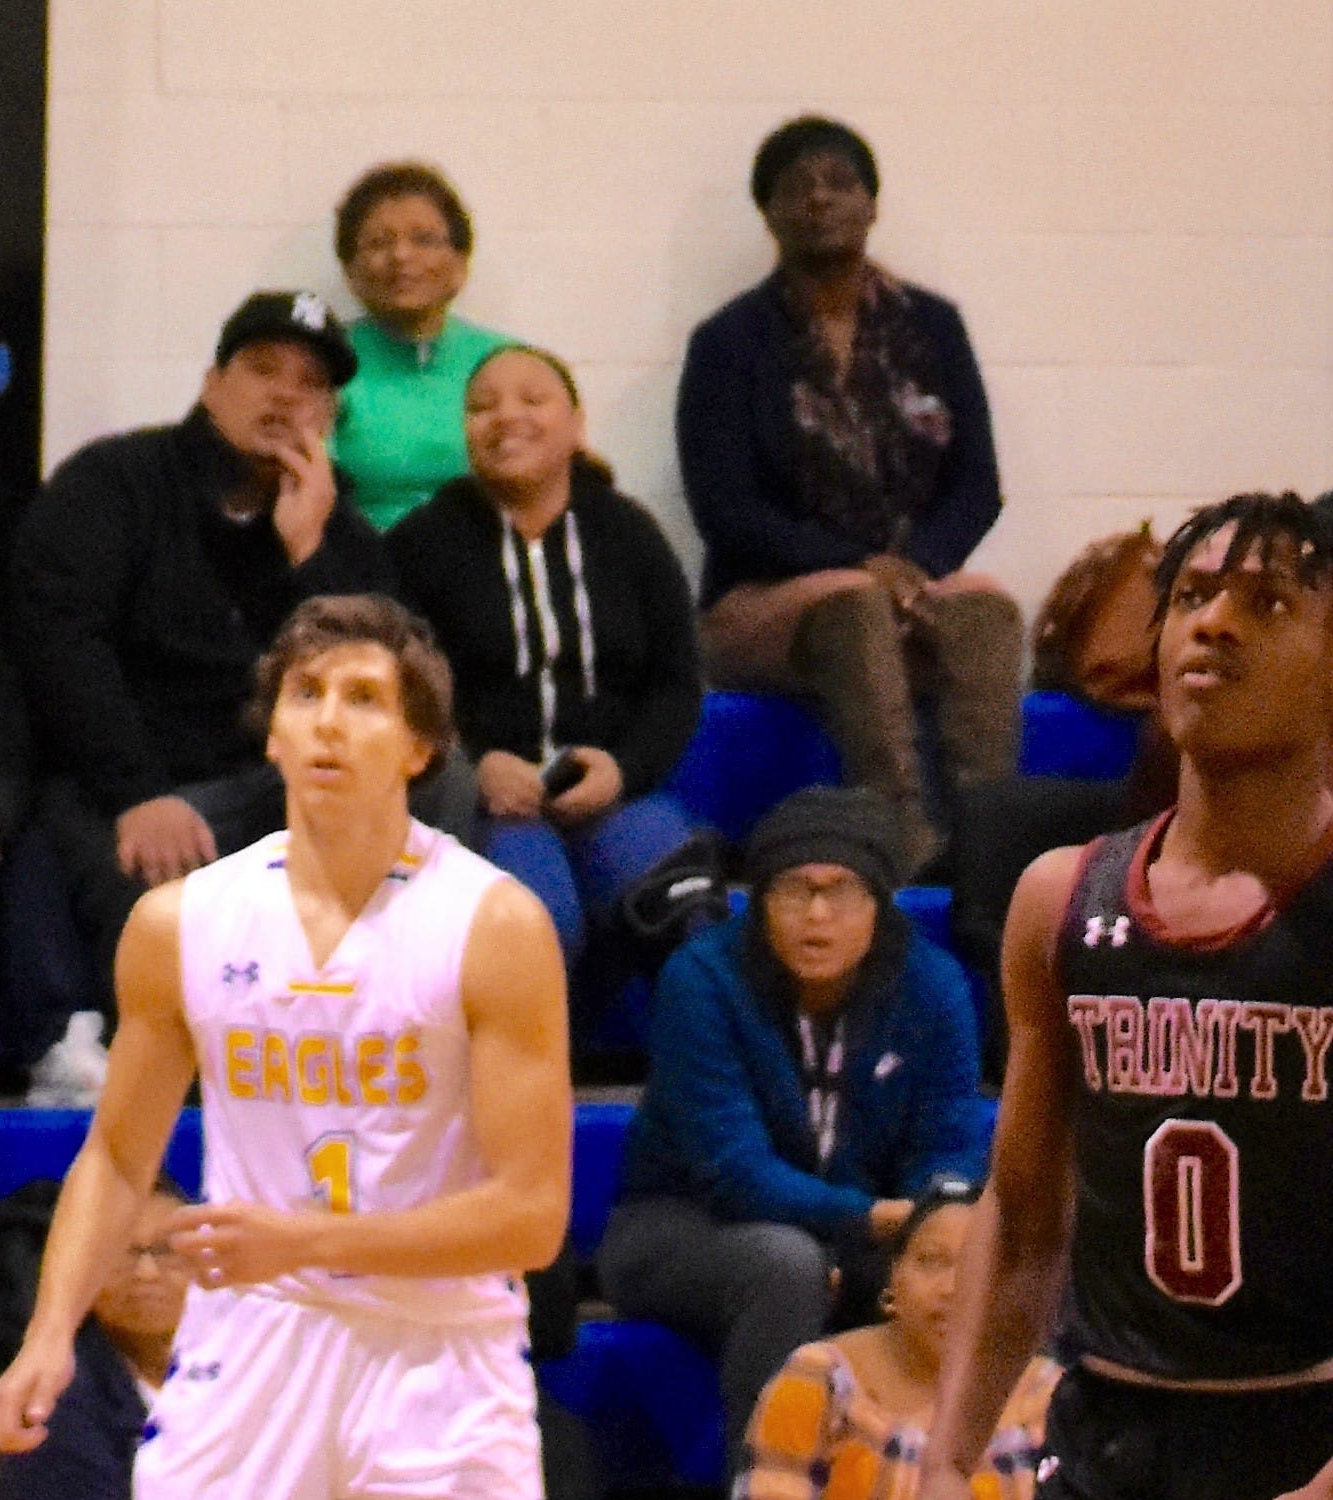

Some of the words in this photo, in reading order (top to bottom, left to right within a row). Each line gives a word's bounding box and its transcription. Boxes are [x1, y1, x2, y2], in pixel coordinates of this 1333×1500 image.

[222, 1024, 429, 1107] EAGLES
[1067, 994, 1333, 1101] TRINITY
[303, 1129, 359, 1215] 1
[1143, 1118, 1244, 1307] 0
